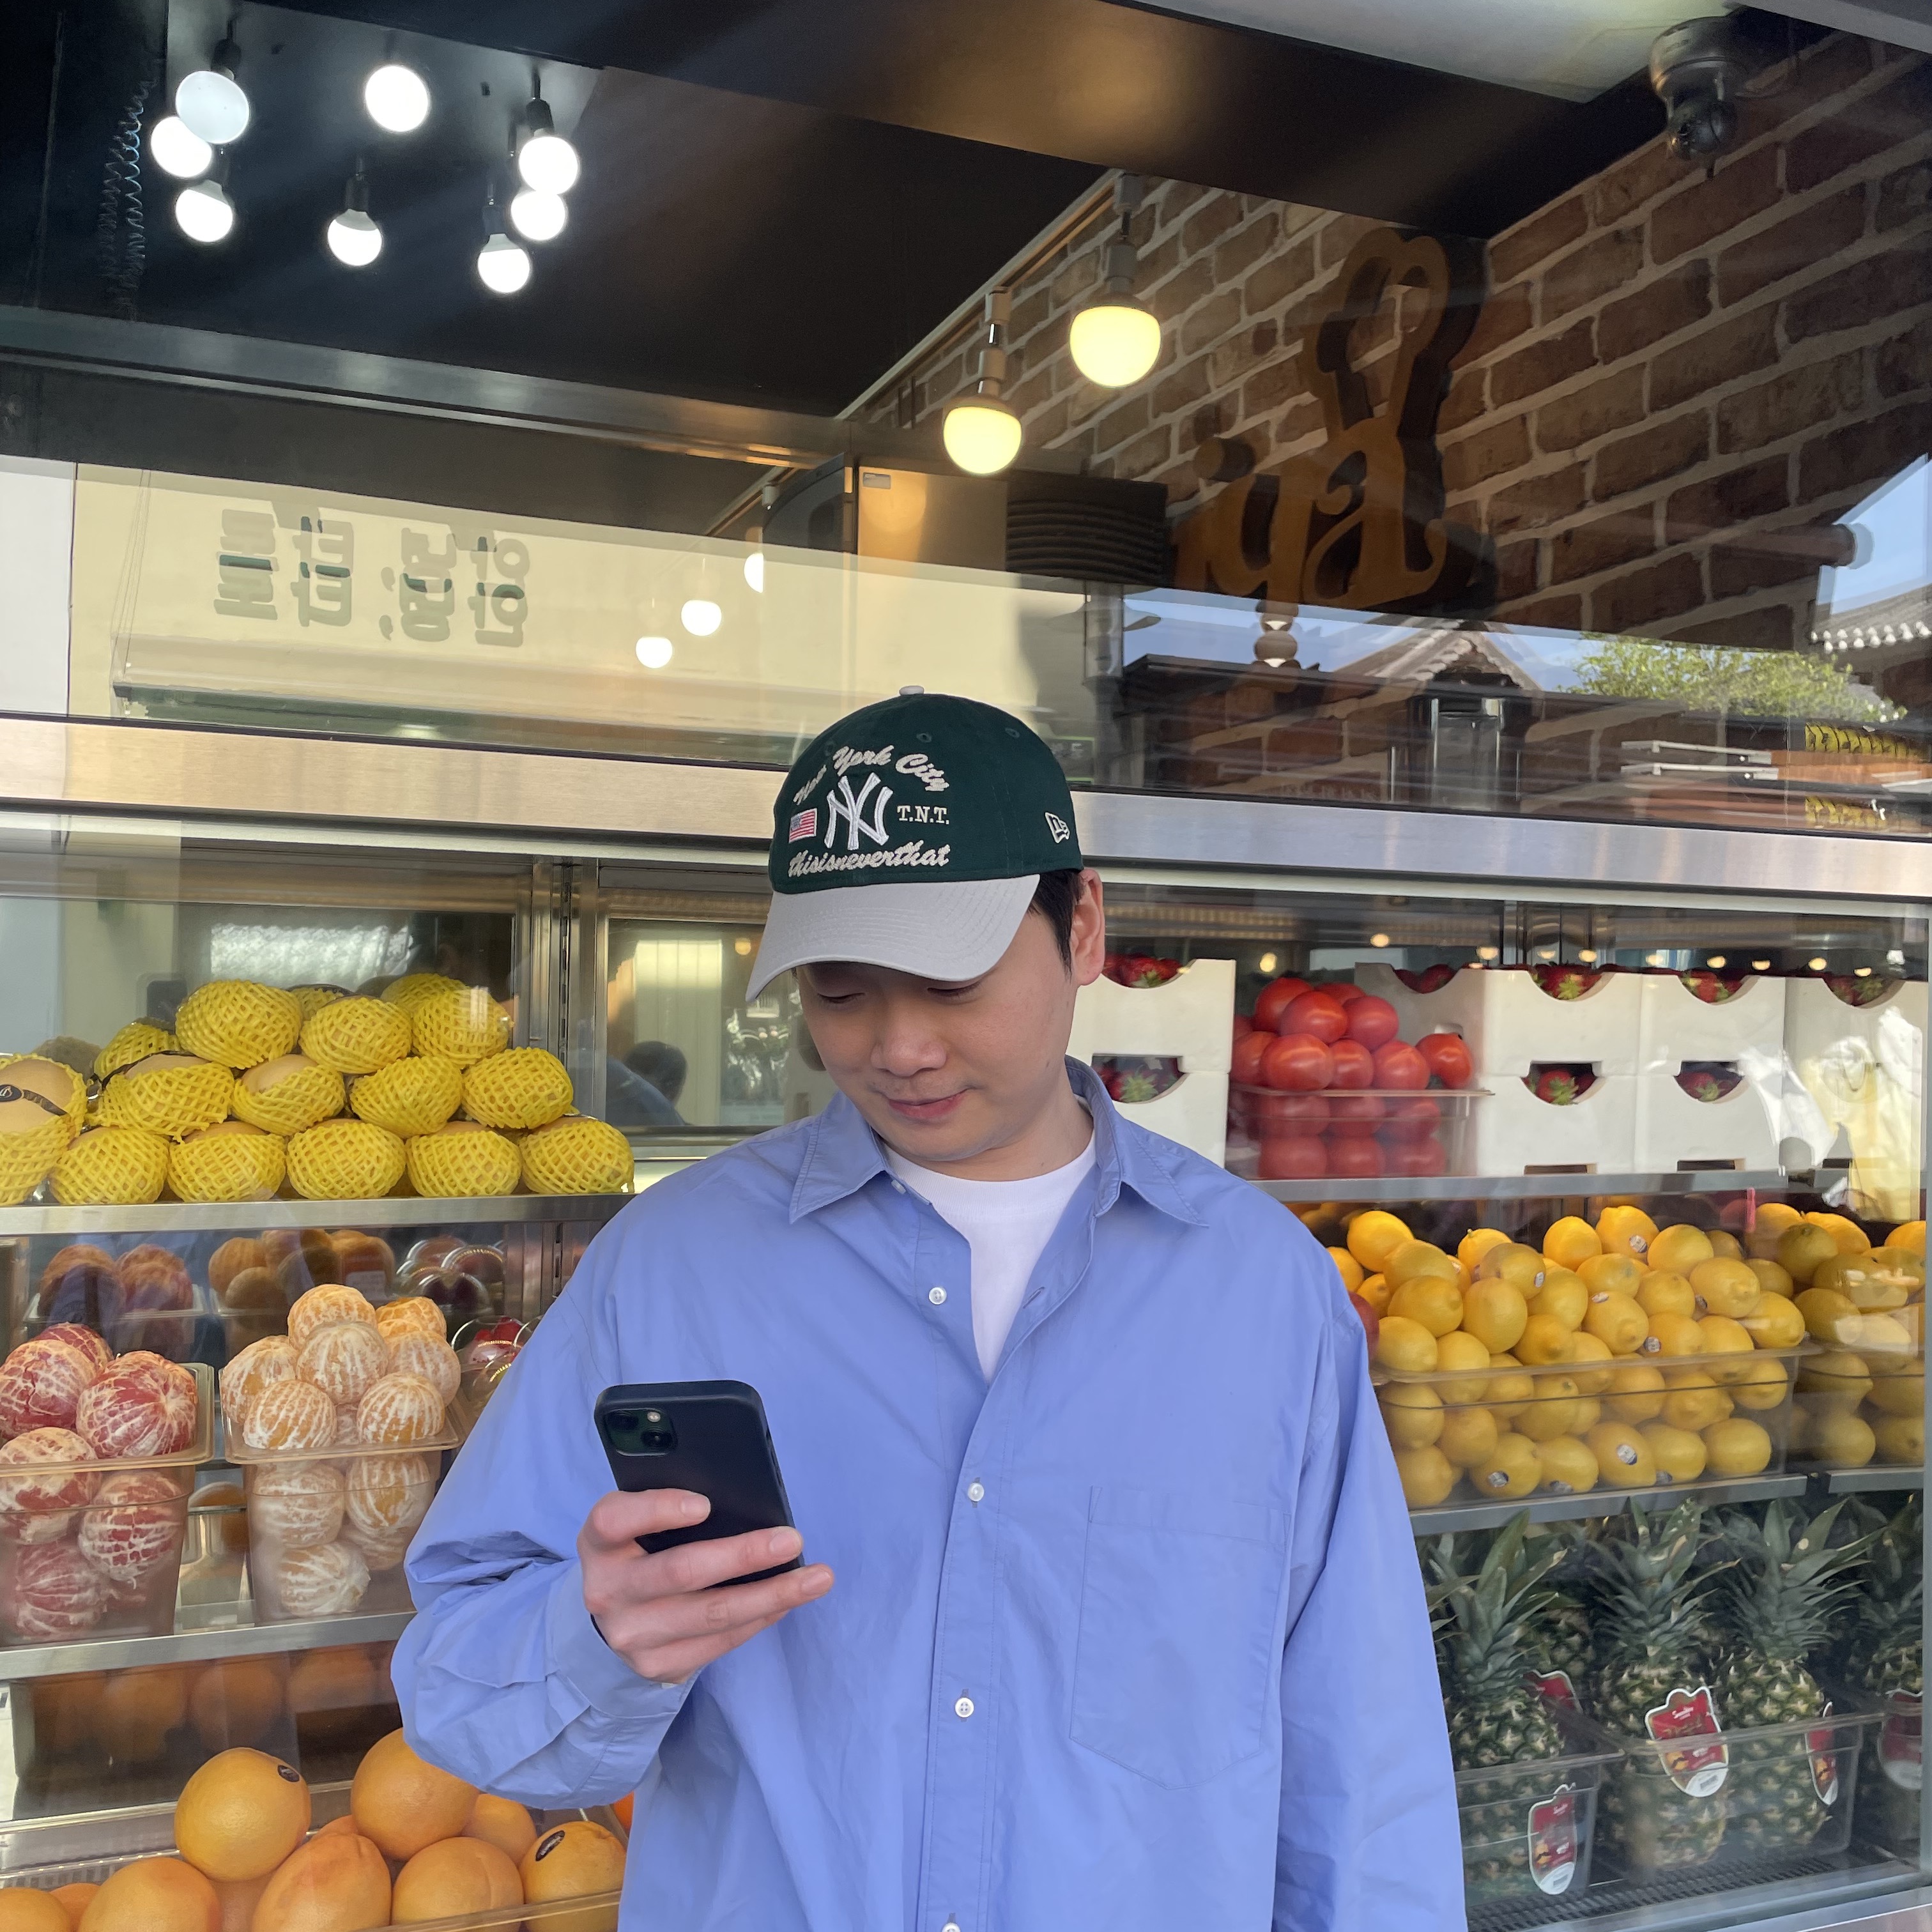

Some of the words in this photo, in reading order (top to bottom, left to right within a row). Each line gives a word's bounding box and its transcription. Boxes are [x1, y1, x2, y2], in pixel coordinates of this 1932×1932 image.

[832, 745, 894, 776] York
[896, 753, 949, 792] City
[824, 772, 893, 850] NY
[897, 805, 949, 824] T.N.T.
[788, 839, 951, 877] thisisneverthat
